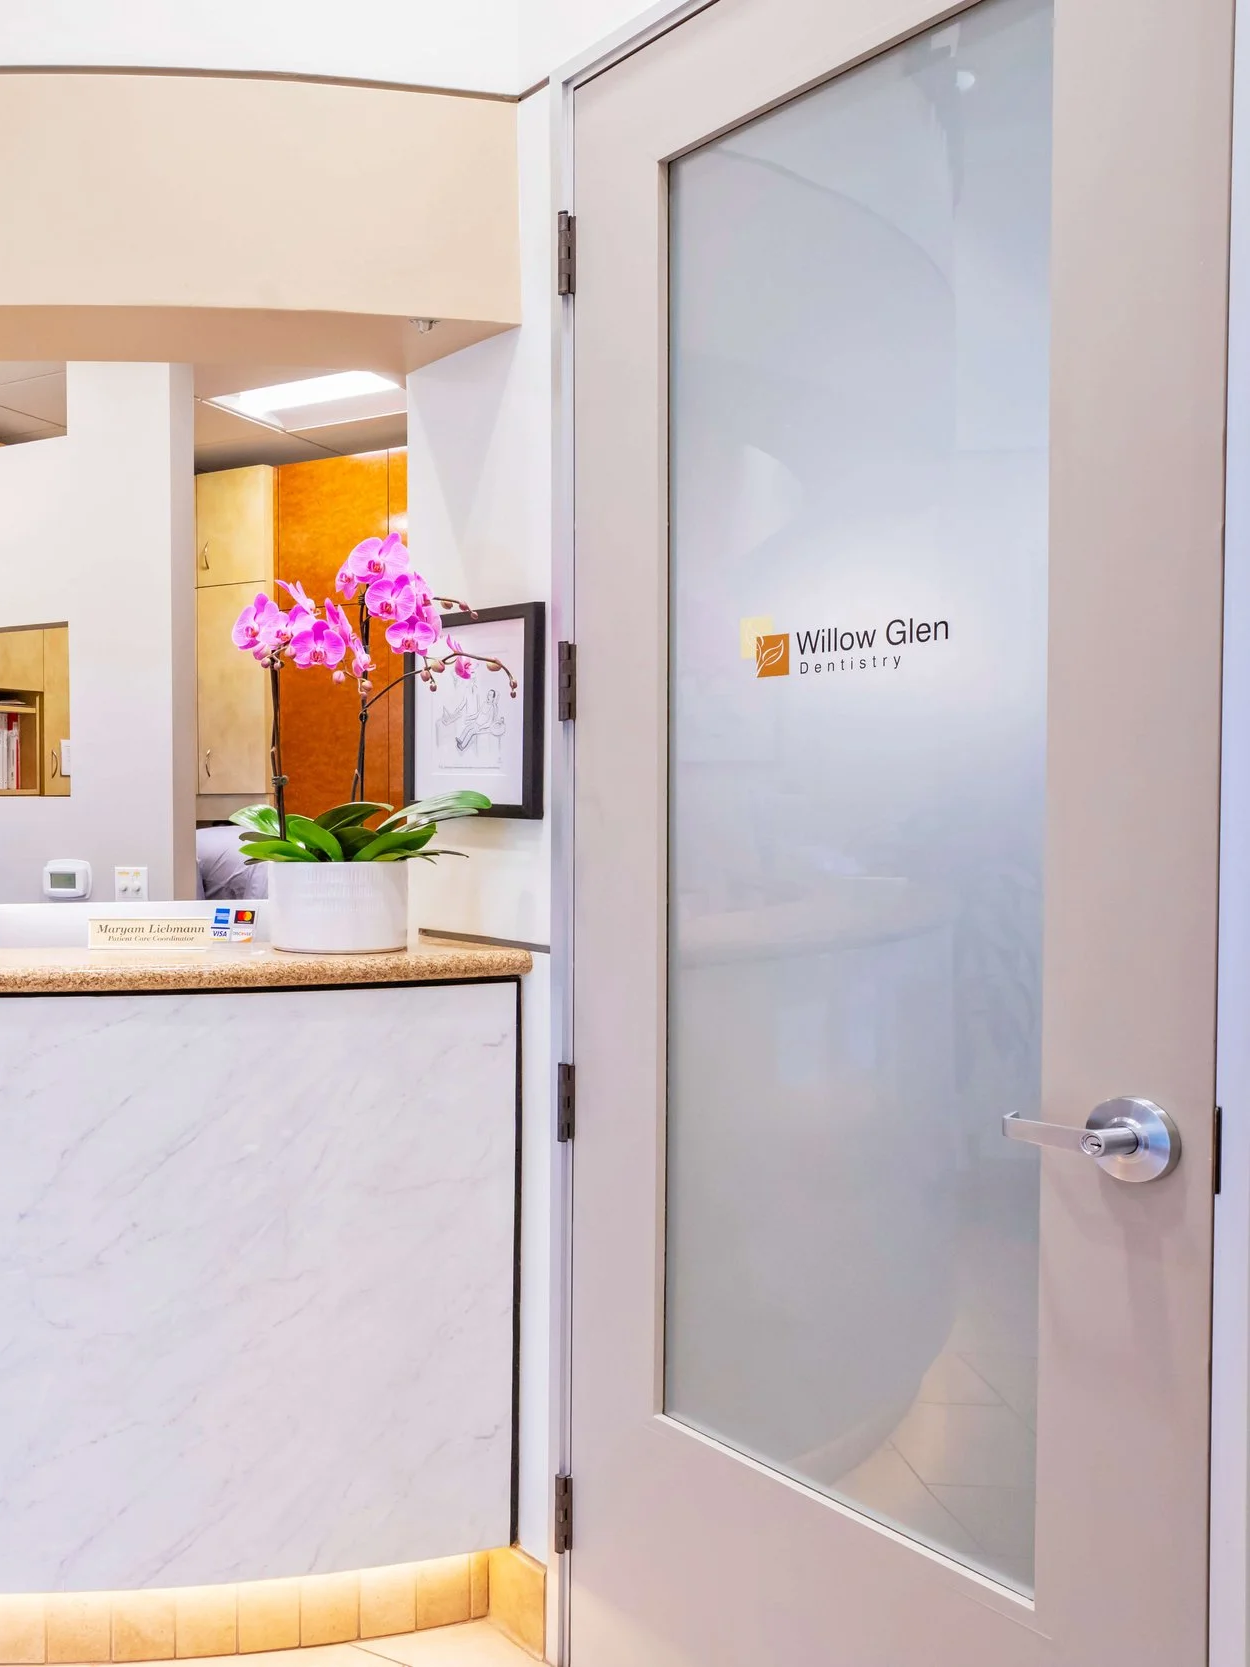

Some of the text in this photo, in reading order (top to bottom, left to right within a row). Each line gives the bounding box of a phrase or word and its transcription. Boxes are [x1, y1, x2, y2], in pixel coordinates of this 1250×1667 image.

[796, 617, 950, 656] Willow Glen
[799, 655, 902, 675] Dentistry
[97, 924, 205, 936] Maryam Liebmann
